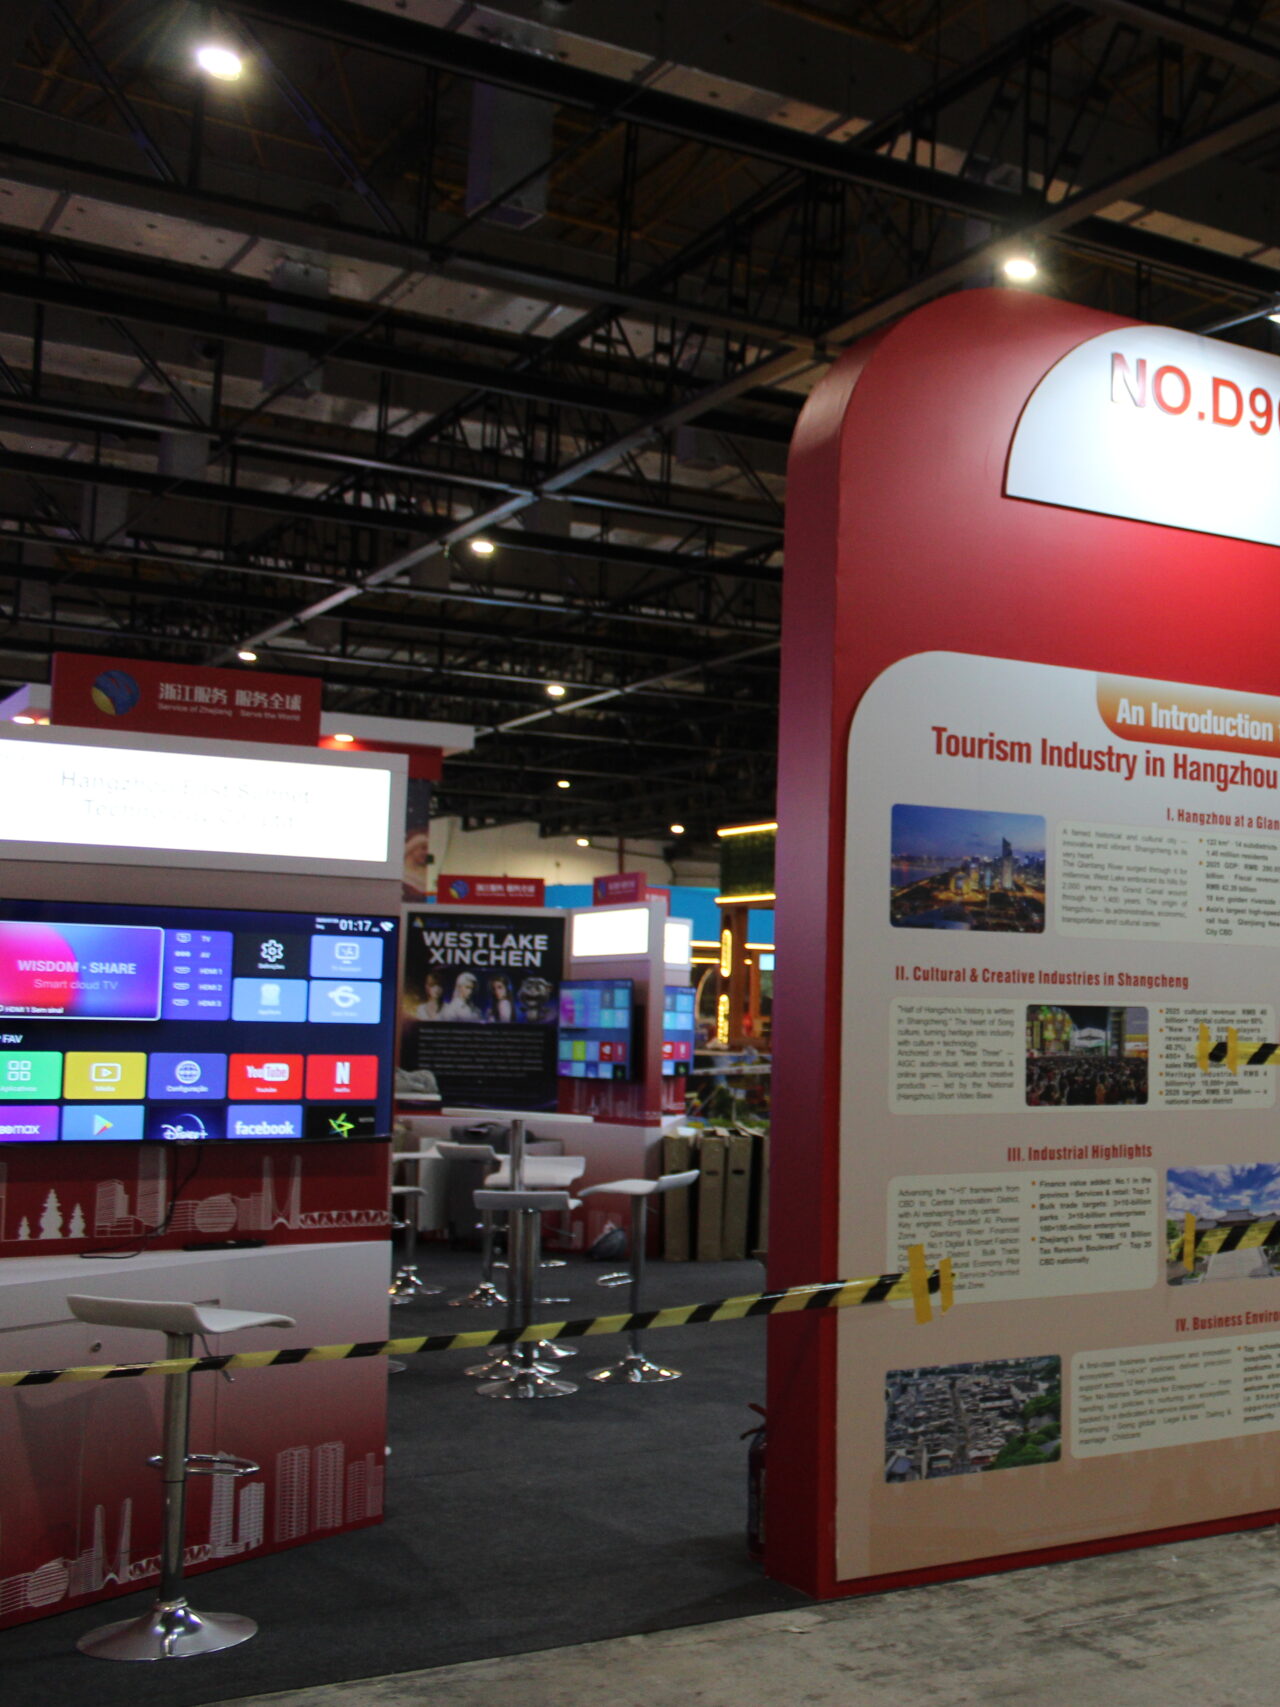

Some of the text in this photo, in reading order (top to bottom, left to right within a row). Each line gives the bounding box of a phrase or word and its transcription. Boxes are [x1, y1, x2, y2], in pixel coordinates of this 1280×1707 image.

[160, 682, 302, 711] 浙江服务 服务全球
[1116, 698, 1145, 726] An
[1151, 702, 1274, 742] Introduction
[930, 725, 1279, 792] Tourism Industry in Hangzhou
[1167, 807, 1175, 821] I.
[1177, 809, 1231, 827] Hangzhou
[1234, 814, 1245, 827] at
[1247, 817, 1254, 828] a
[339, 919, 372, 931] 01:17
[423, 931, 548, 950] WESTLAKE
[17, 959, 137, 975] WISDOM SHARE
[429, 949, 541, 967] XINCHEN
[34, 978, 119, 990] Smart cloud TV
[895, 966, 1190, 990] II. Cultural & Creative Industries in Shangcheng
[2, 1034, 23, 1044] FAV
[246, 1062, 290, 1081] YouTube
[336, 1062, 350, 1085] N
[235, 1121, 295, 1136] facebook
[1007, 1143, 1153, 1162] III. Industrial Highlights
[1175, 1318, 1190, 1333] IV.
[1192, 1312, 1243, 1331] Business
